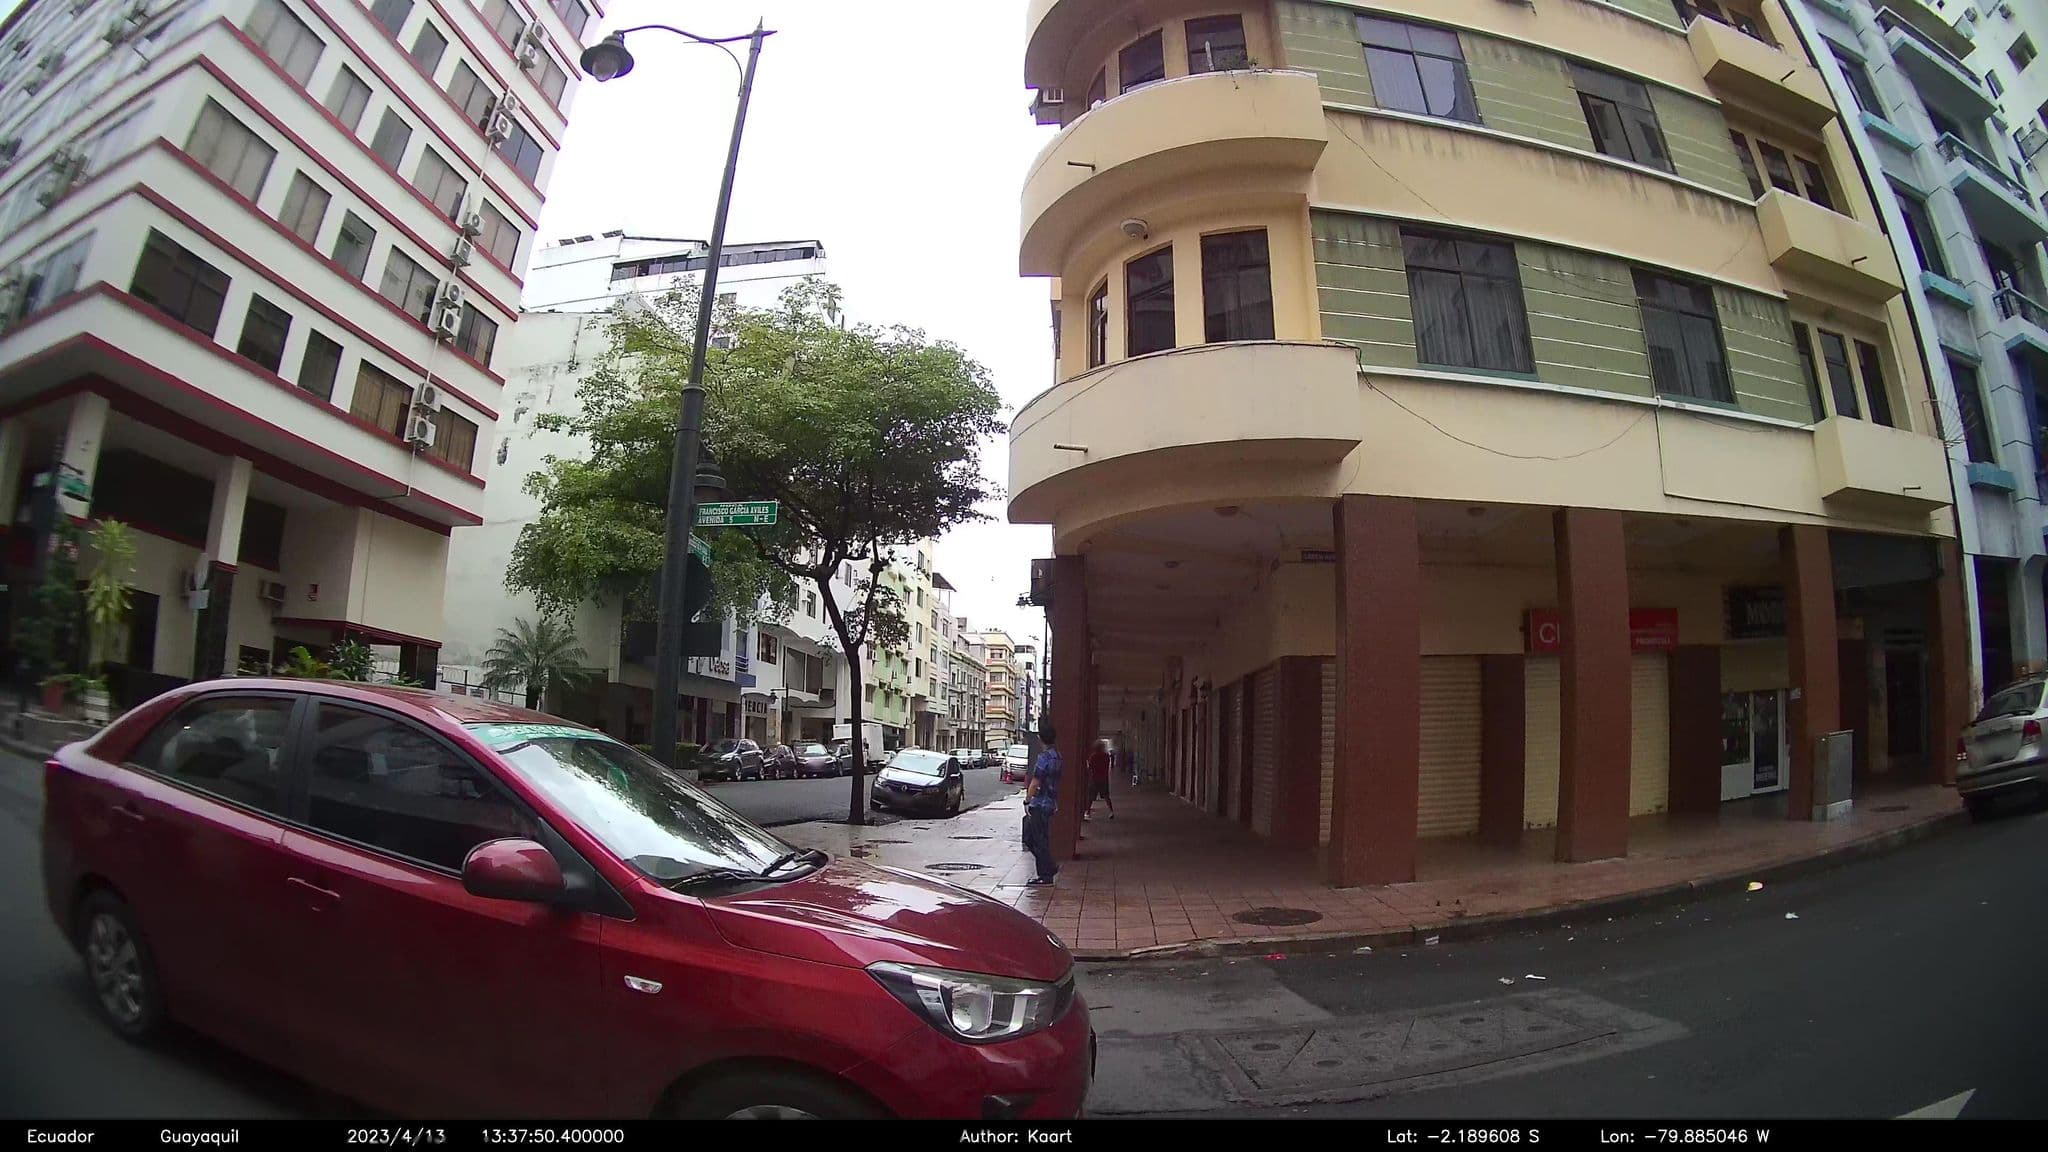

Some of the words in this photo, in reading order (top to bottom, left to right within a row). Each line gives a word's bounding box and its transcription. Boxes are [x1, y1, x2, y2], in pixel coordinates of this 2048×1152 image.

[698, 506, 728, 516] FRANCISCO
[729, 505, 749, 515] GARCIA
[750, 505, 769, 514] AVILES
[698, 515, 725, 524] AVENIDA
